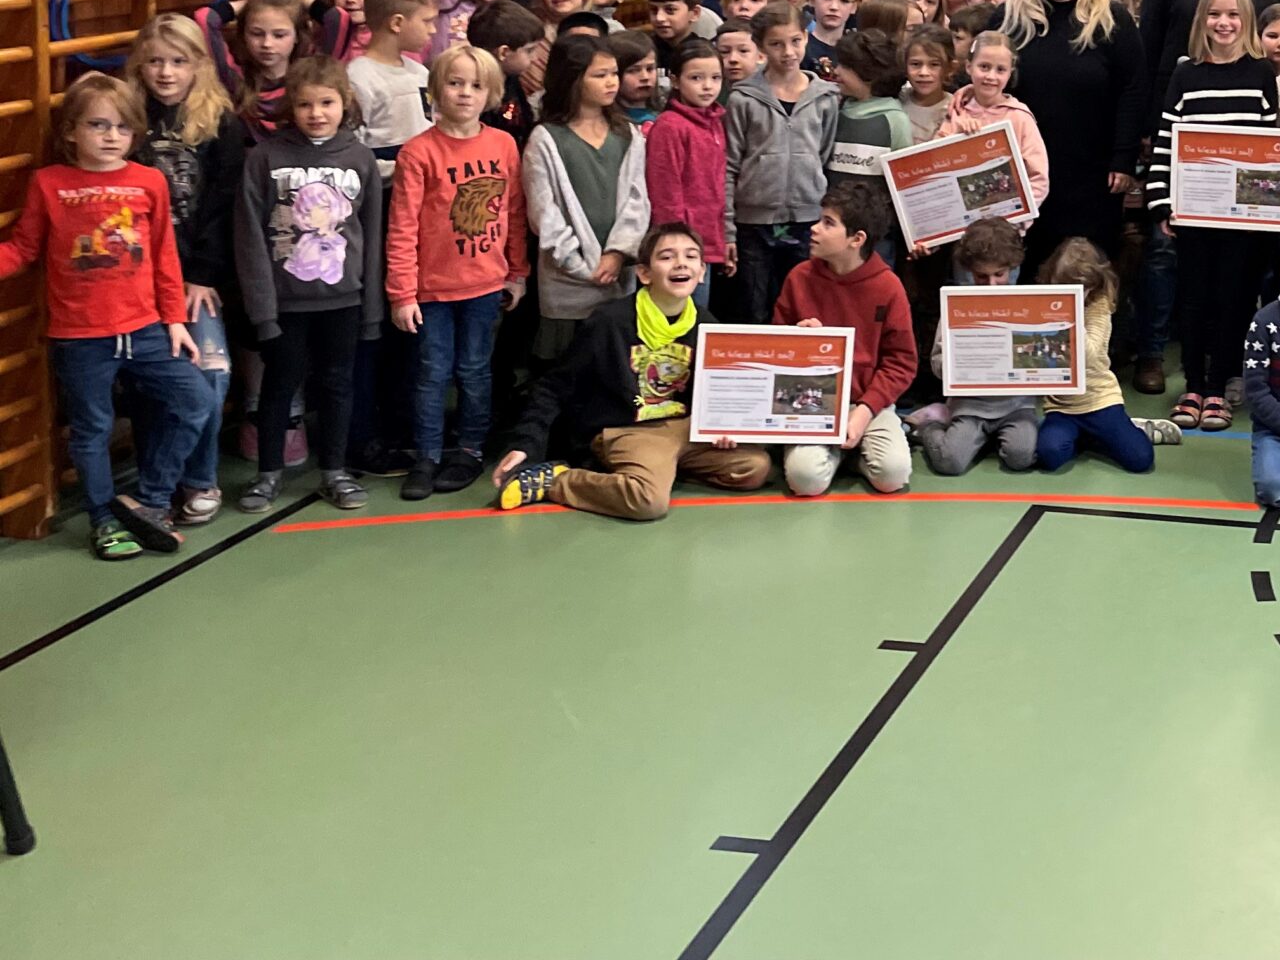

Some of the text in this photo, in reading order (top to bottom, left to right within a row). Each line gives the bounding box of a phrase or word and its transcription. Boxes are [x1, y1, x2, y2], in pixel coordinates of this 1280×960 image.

[1183, 144, 1195, 152] Die
[447, 159, 501, 184] TALK
[897, 169, 910, 180] Die
[953, 309, 965, 317] Die
[711, 348, 724, 357] Die
